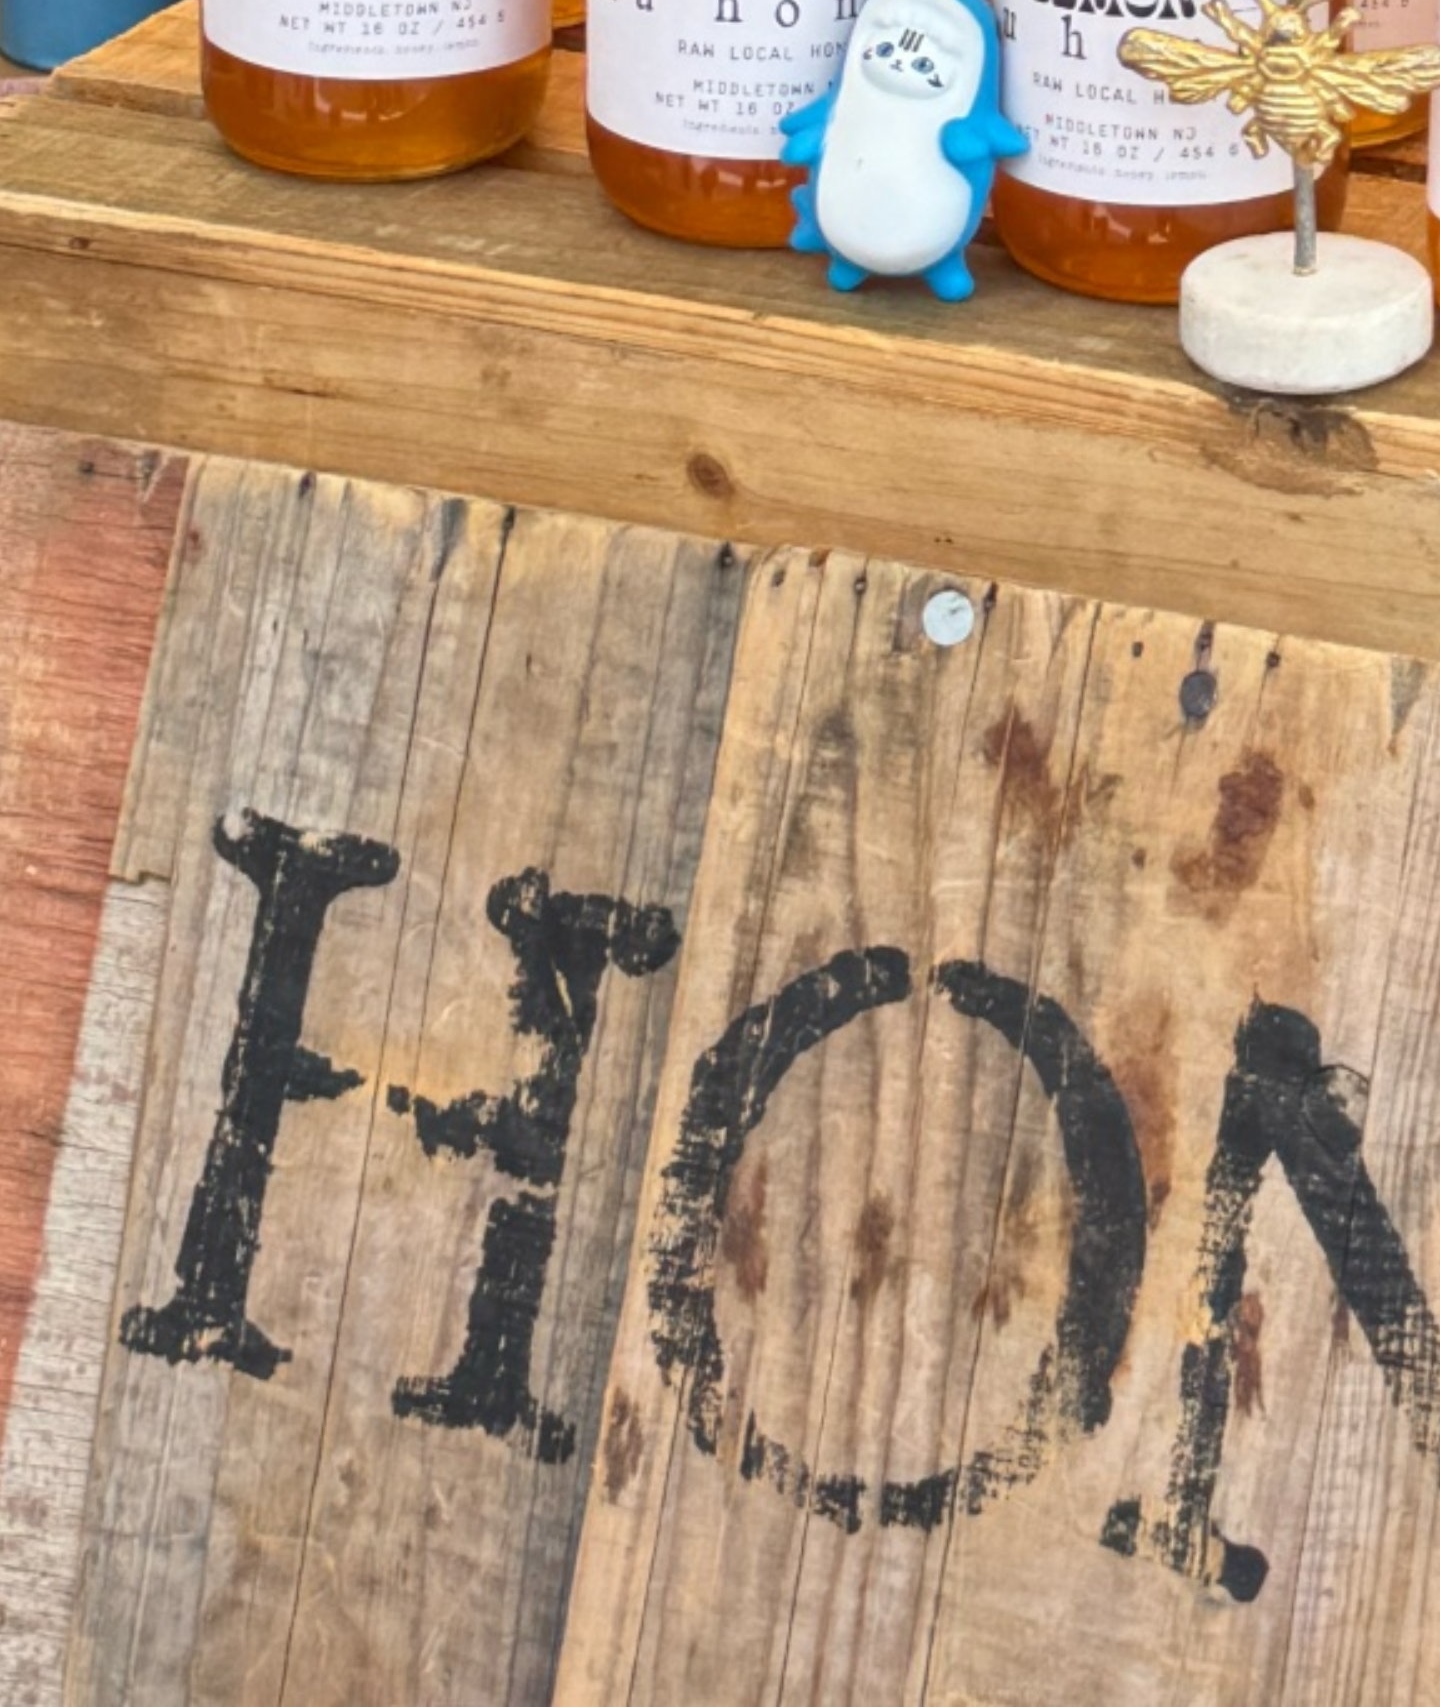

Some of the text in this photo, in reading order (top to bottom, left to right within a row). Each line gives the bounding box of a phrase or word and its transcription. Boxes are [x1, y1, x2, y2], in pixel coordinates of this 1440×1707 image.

[320, 1, 439, 18] MIDDLETOWN
[278, 14, 310, 31] NET
[323, 20, 346, 35] WT
[361, 20, 383, 35] 16
[398, 20, 420, 35] OZ
[456, 12, 487, 29] 454
[678, 39, 848, 61] RAW LOCAL HON
[693, 79, 815, 97] MIDDLETOWN
[1033, 71, 1062, 91] RAW
[1075, 83, 1137, 104] LOCAL
[655, 91, 685, 107] NET
[698, 99, 720, 113] WT
[736, 101, 757, 116] 16
[1045, 113, 1197, 141] MIDDLETOWN NJ
[1050, 136, 1069, 150] WT
[1083, 141, 1102, 157] 16
[1118, 145, 1139, 160] OZ
[1180, 145, 1215, 160] 454
